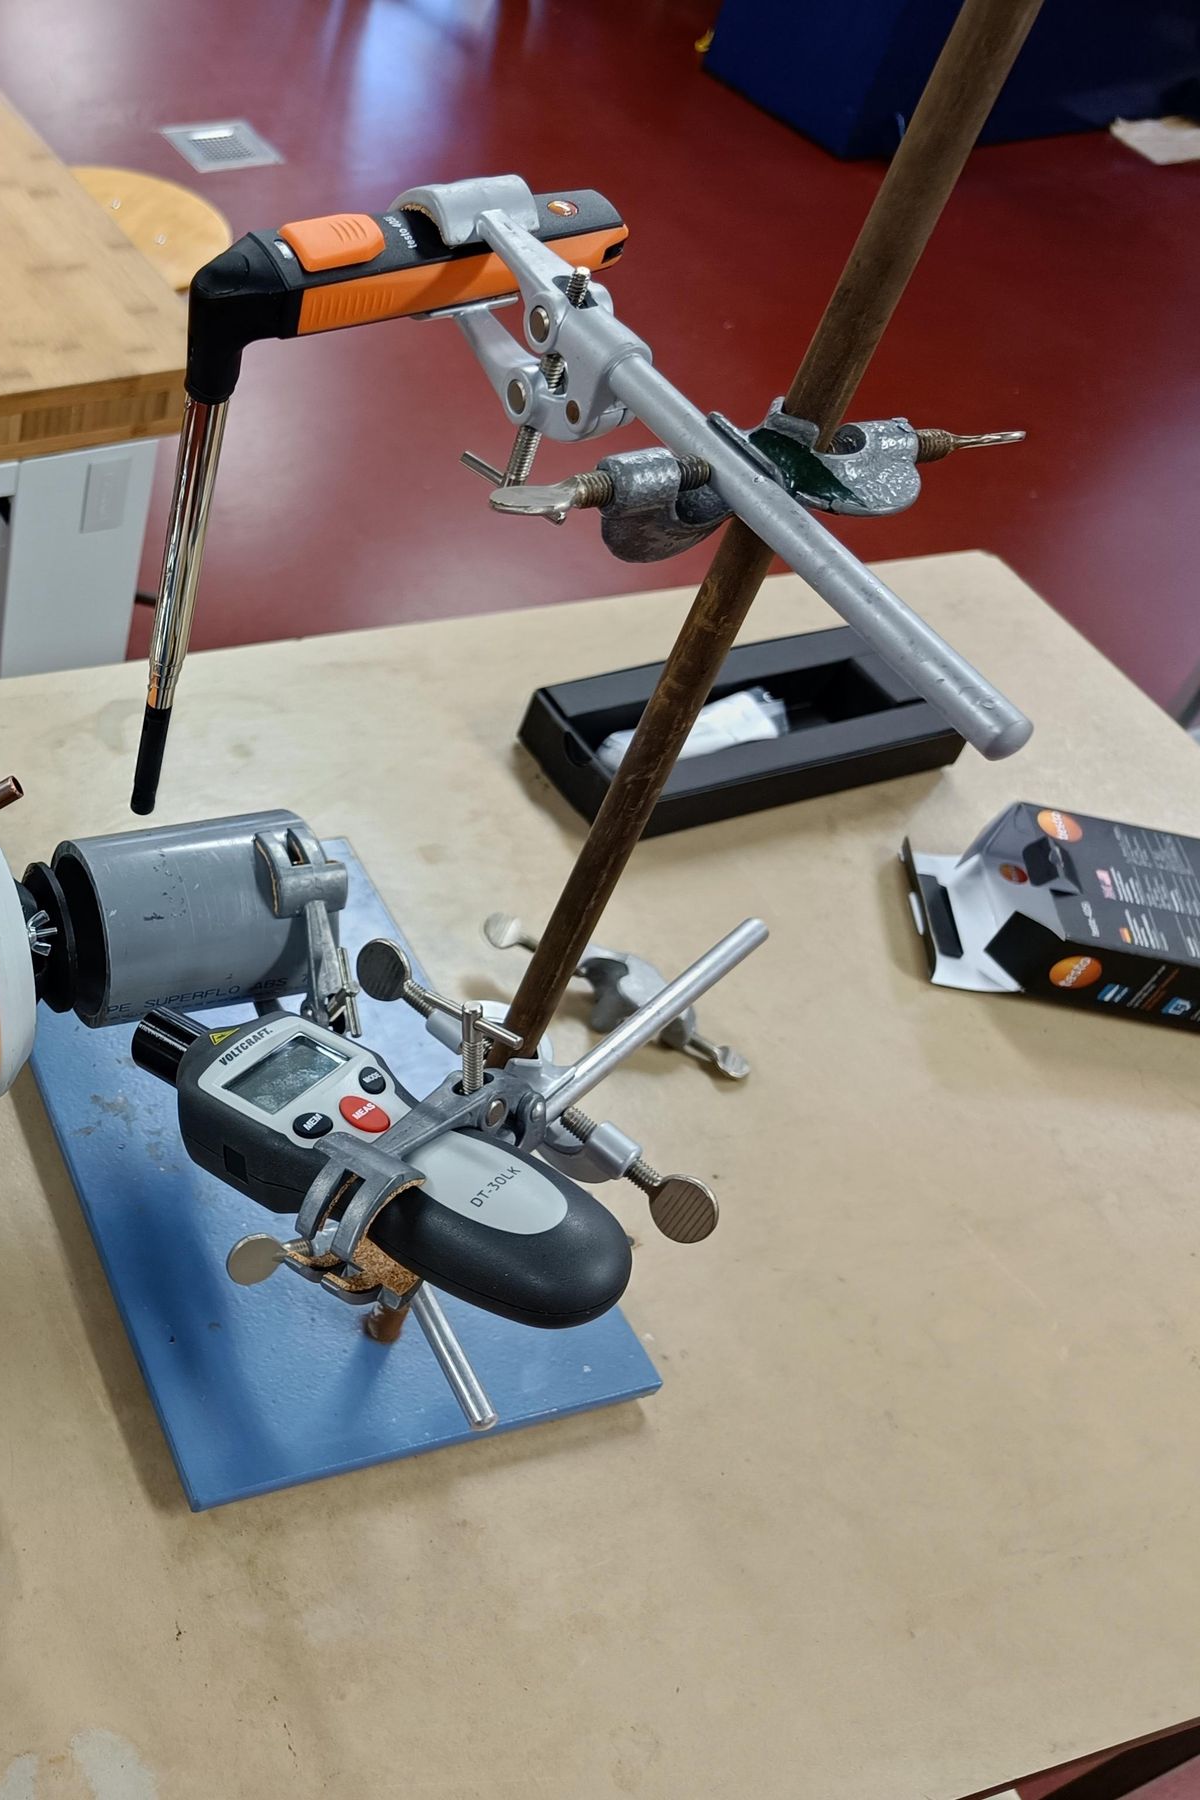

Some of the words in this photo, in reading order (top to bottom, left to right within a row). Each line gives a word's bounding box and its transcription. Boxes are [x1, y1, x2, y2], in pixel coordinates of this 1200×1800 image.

[399, 228, 417, 249] testo
[143, 985, 241, 1009] SUPERFLO
[253, 977, 288, 991] ABS
[352, 1102, 376, 1120] MEAS
[302, 1113, 323, 1131] MEM
[470, 1166, 521, 1208] DT-30LK
